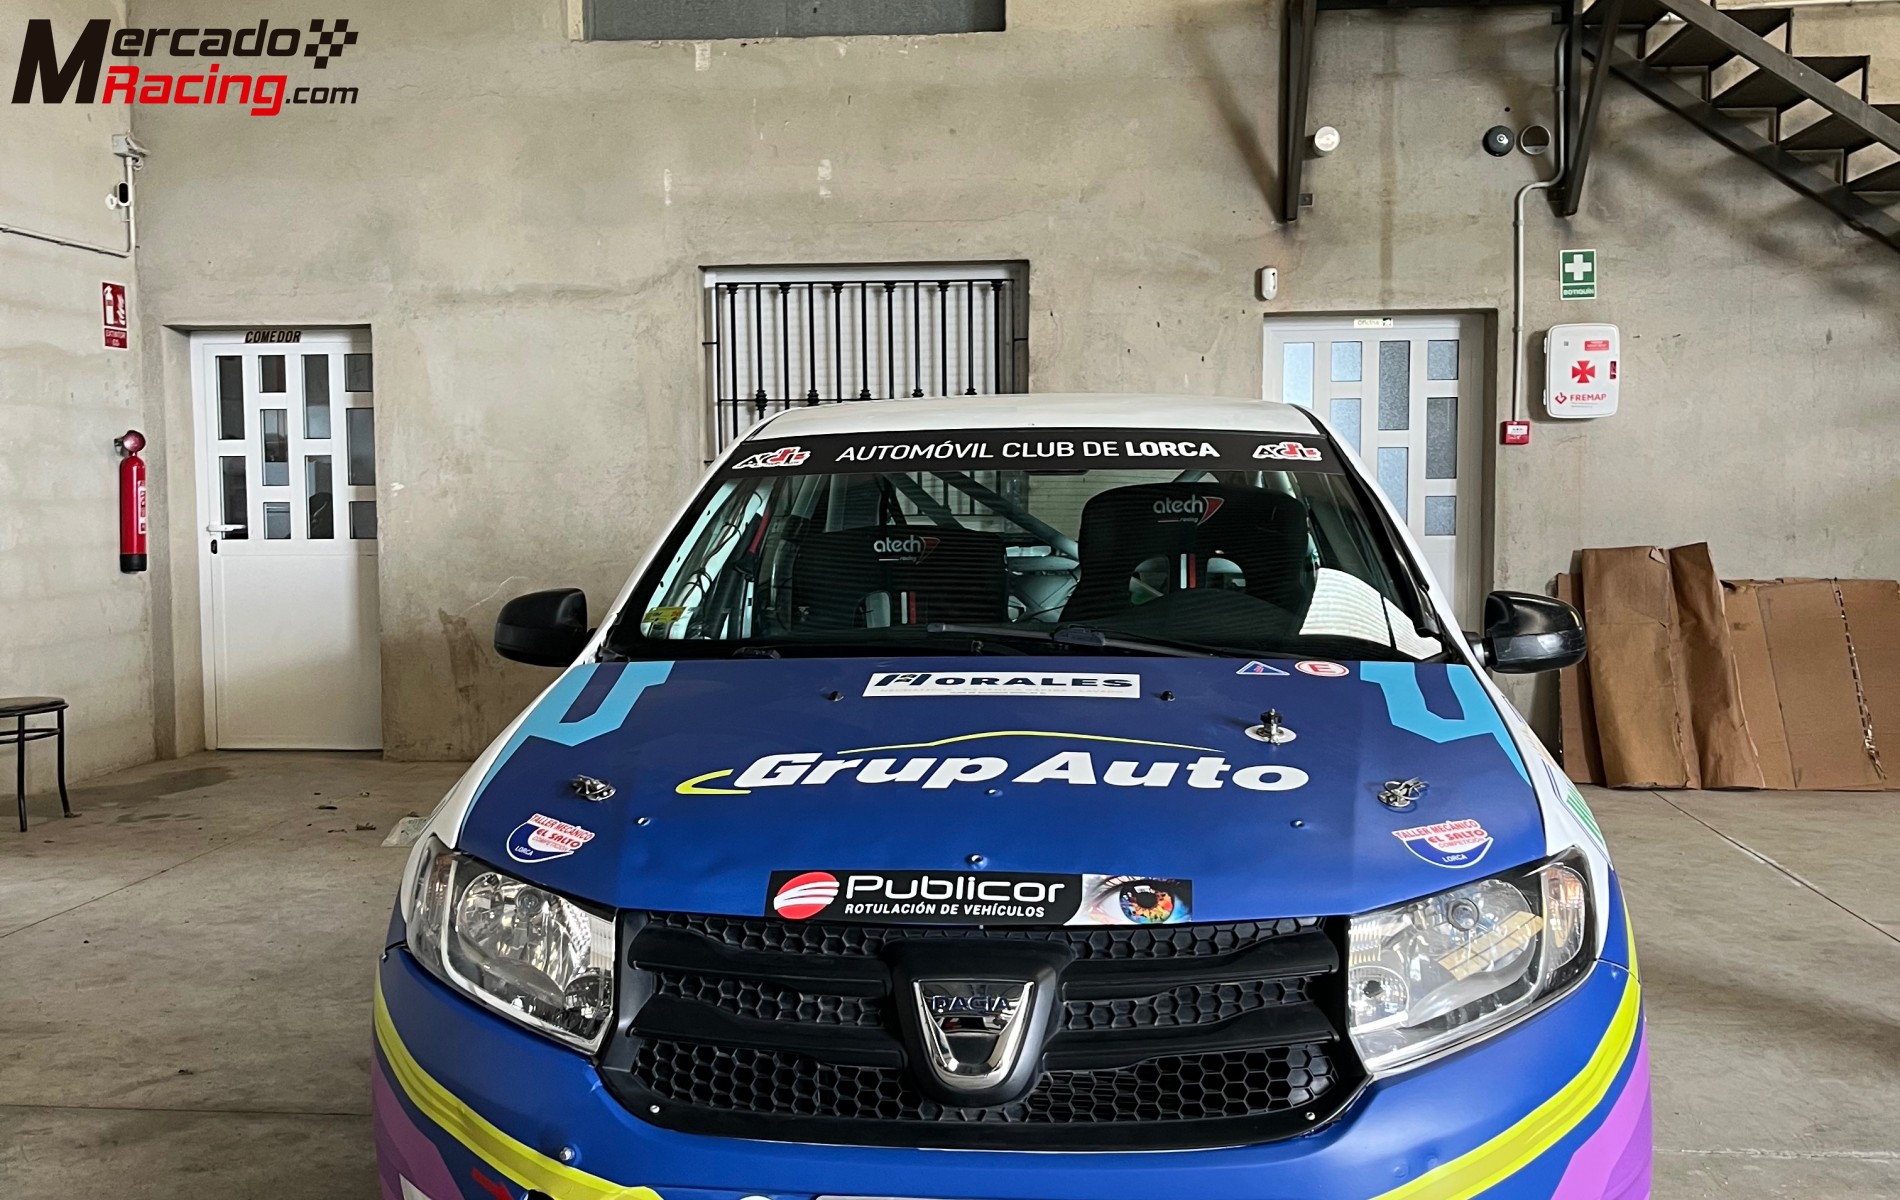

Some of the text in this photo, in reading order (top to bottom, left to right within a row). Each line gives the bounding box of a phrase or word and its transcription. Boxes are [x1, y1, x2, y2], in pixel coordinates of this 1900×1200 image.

[244, 330, 301, 343] COMEDOR
[1570, 393, 1607, 402] FREMAP
[834, 441, 1221, 462] AUTOMÓVIL CLUB DE LORCA
[1152, 494, 1204, 514] atech
[873, 534, 921, 553] atech
[734, 751, 1310, 791] Grup Auto
[530, 815, 592, 840] TALLER MECÁNICO
[1394, 820, 1479, 839] TALLER MECÁNICO
[1427, 828, 1485, 843] EL SALTO
[536, 828, 581, 848] EL SALTO
[515, 846, 533, 856] LORCA
[1442, 854, 1467, 862] LORCA
[846, 875, 1066, 903] Publicor
[844, 901, 1045, 918] ROTULACIÓN DE VEHÍCULOS
[931, 995, 1011, 1013] DACIA
